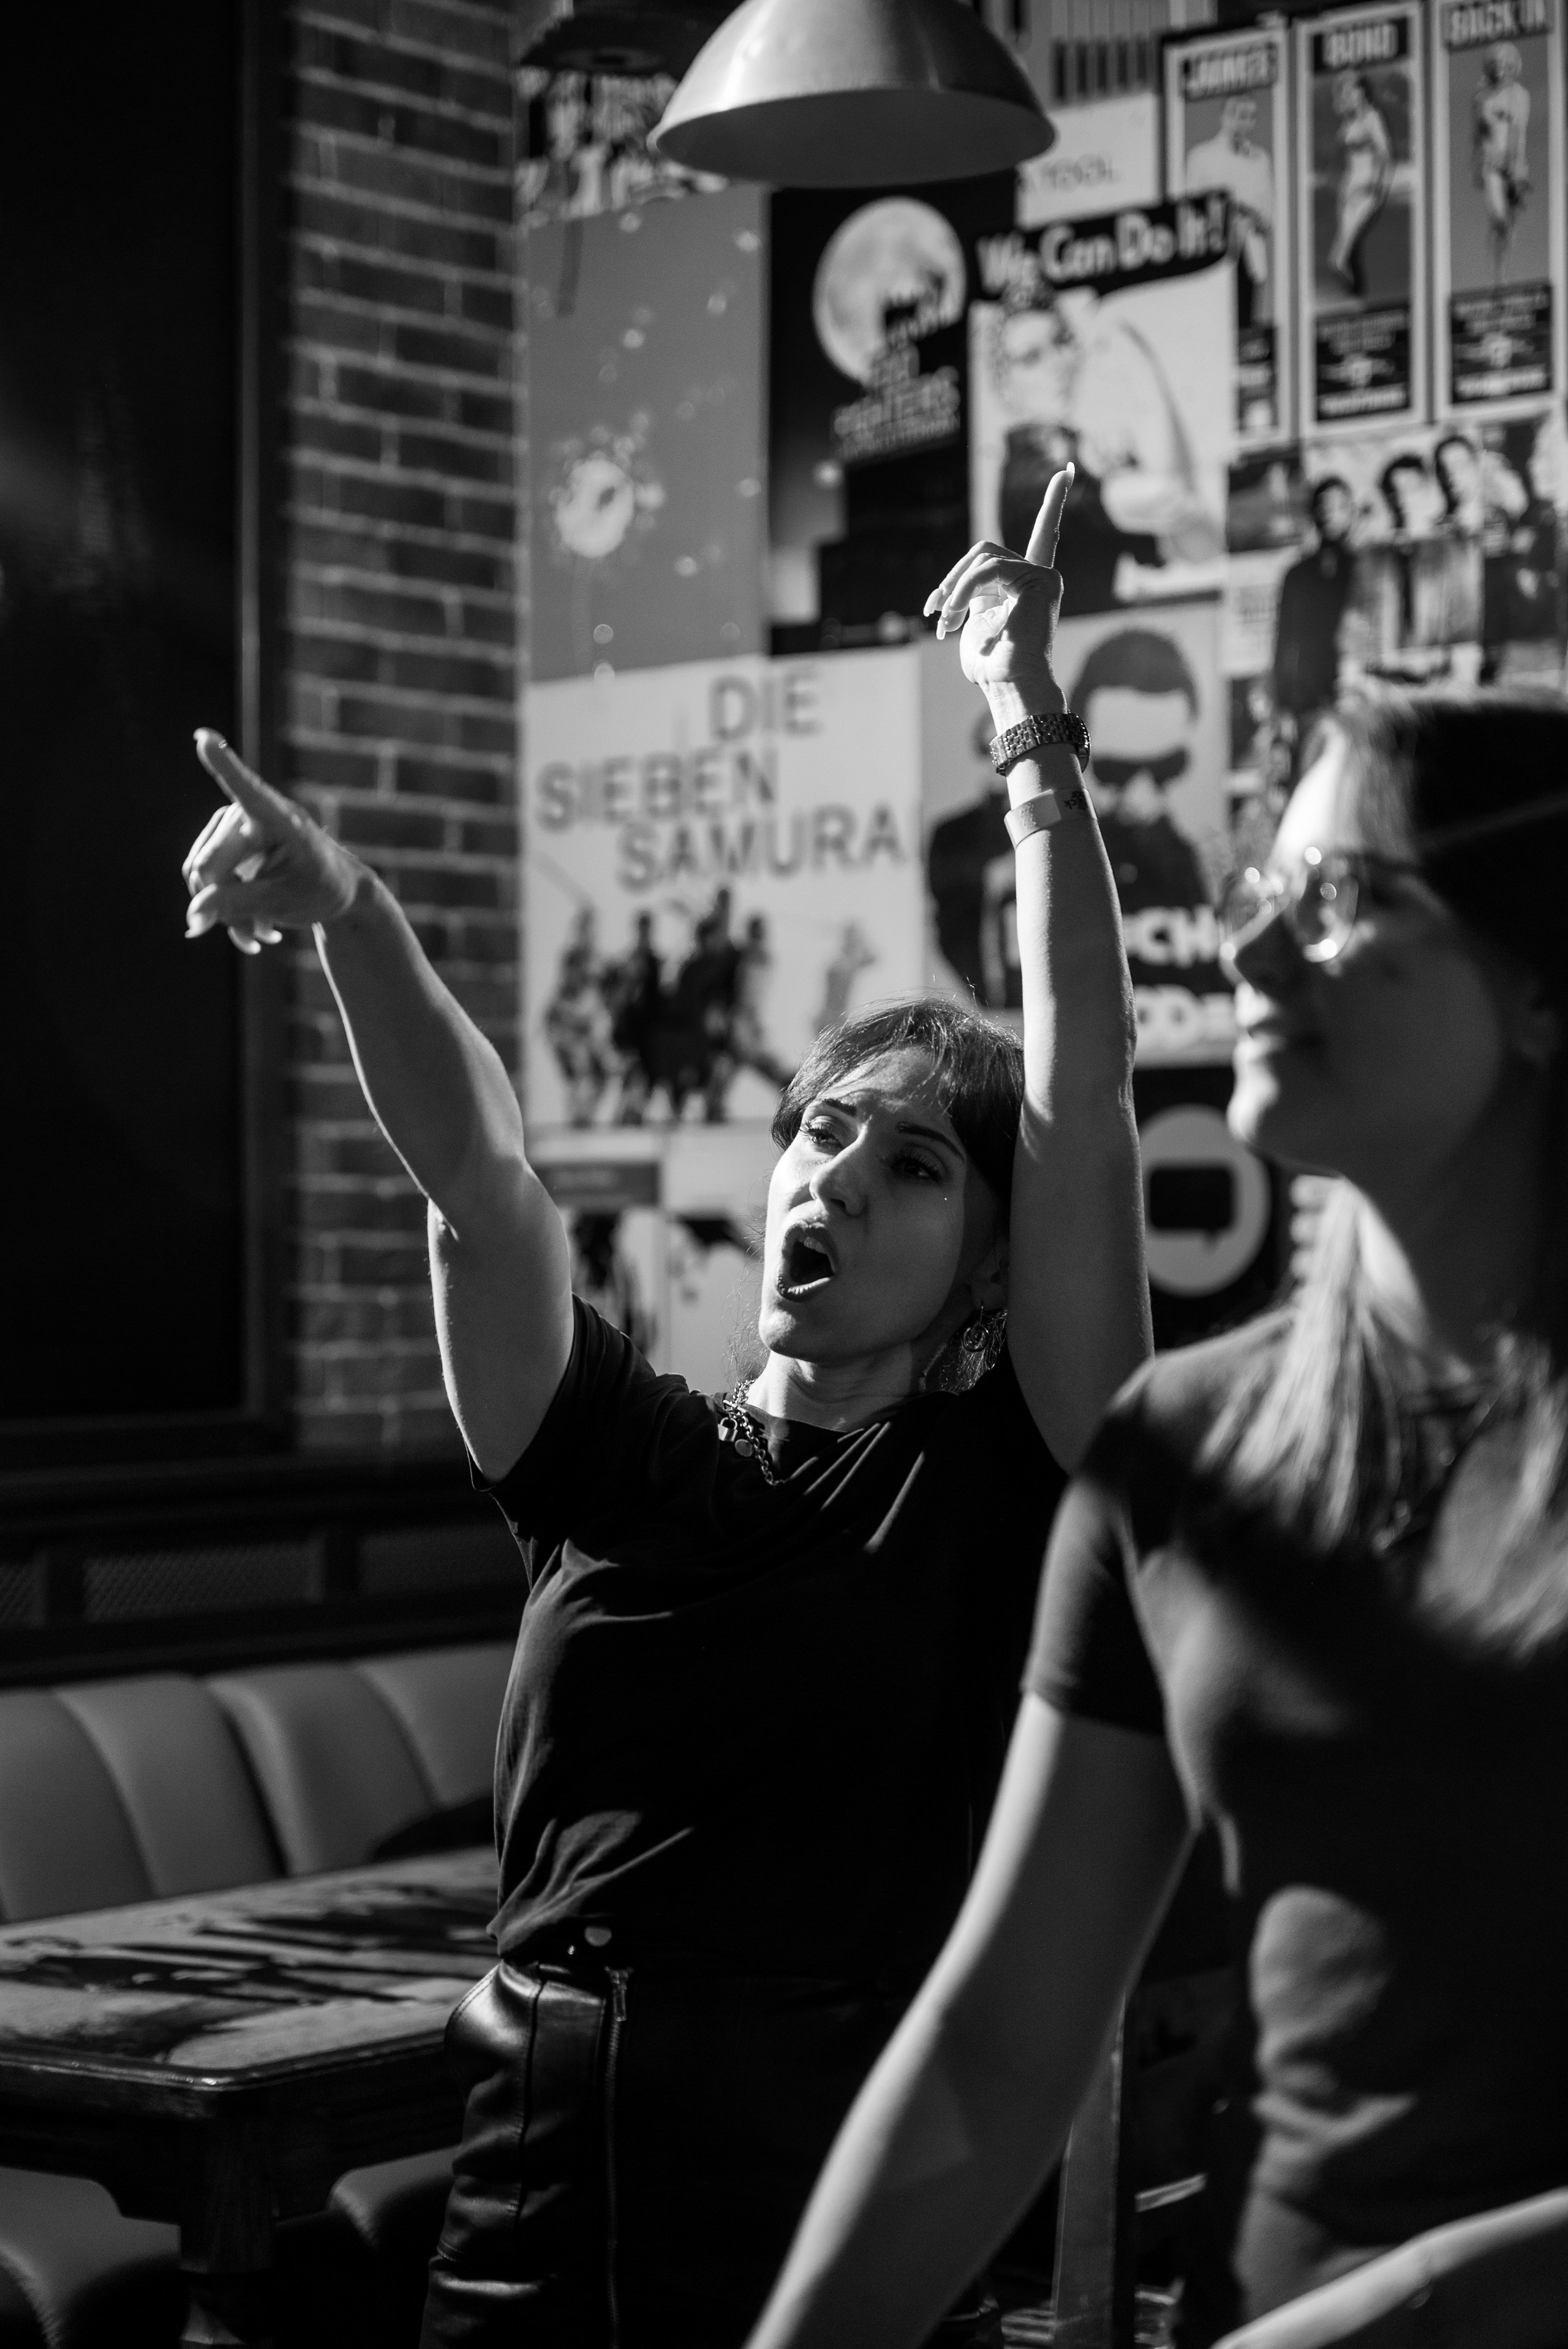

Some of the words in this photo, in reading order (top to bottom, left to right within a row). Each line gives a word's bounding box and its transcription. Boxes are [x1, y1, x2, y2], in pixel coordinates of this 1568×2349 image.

[1039, 222, 1116, 283] Can
[1114, 210, 1176, 270] Do
[707, 665, 822, 742] DIE
[536, 745, 779, 834] SIEBEN
